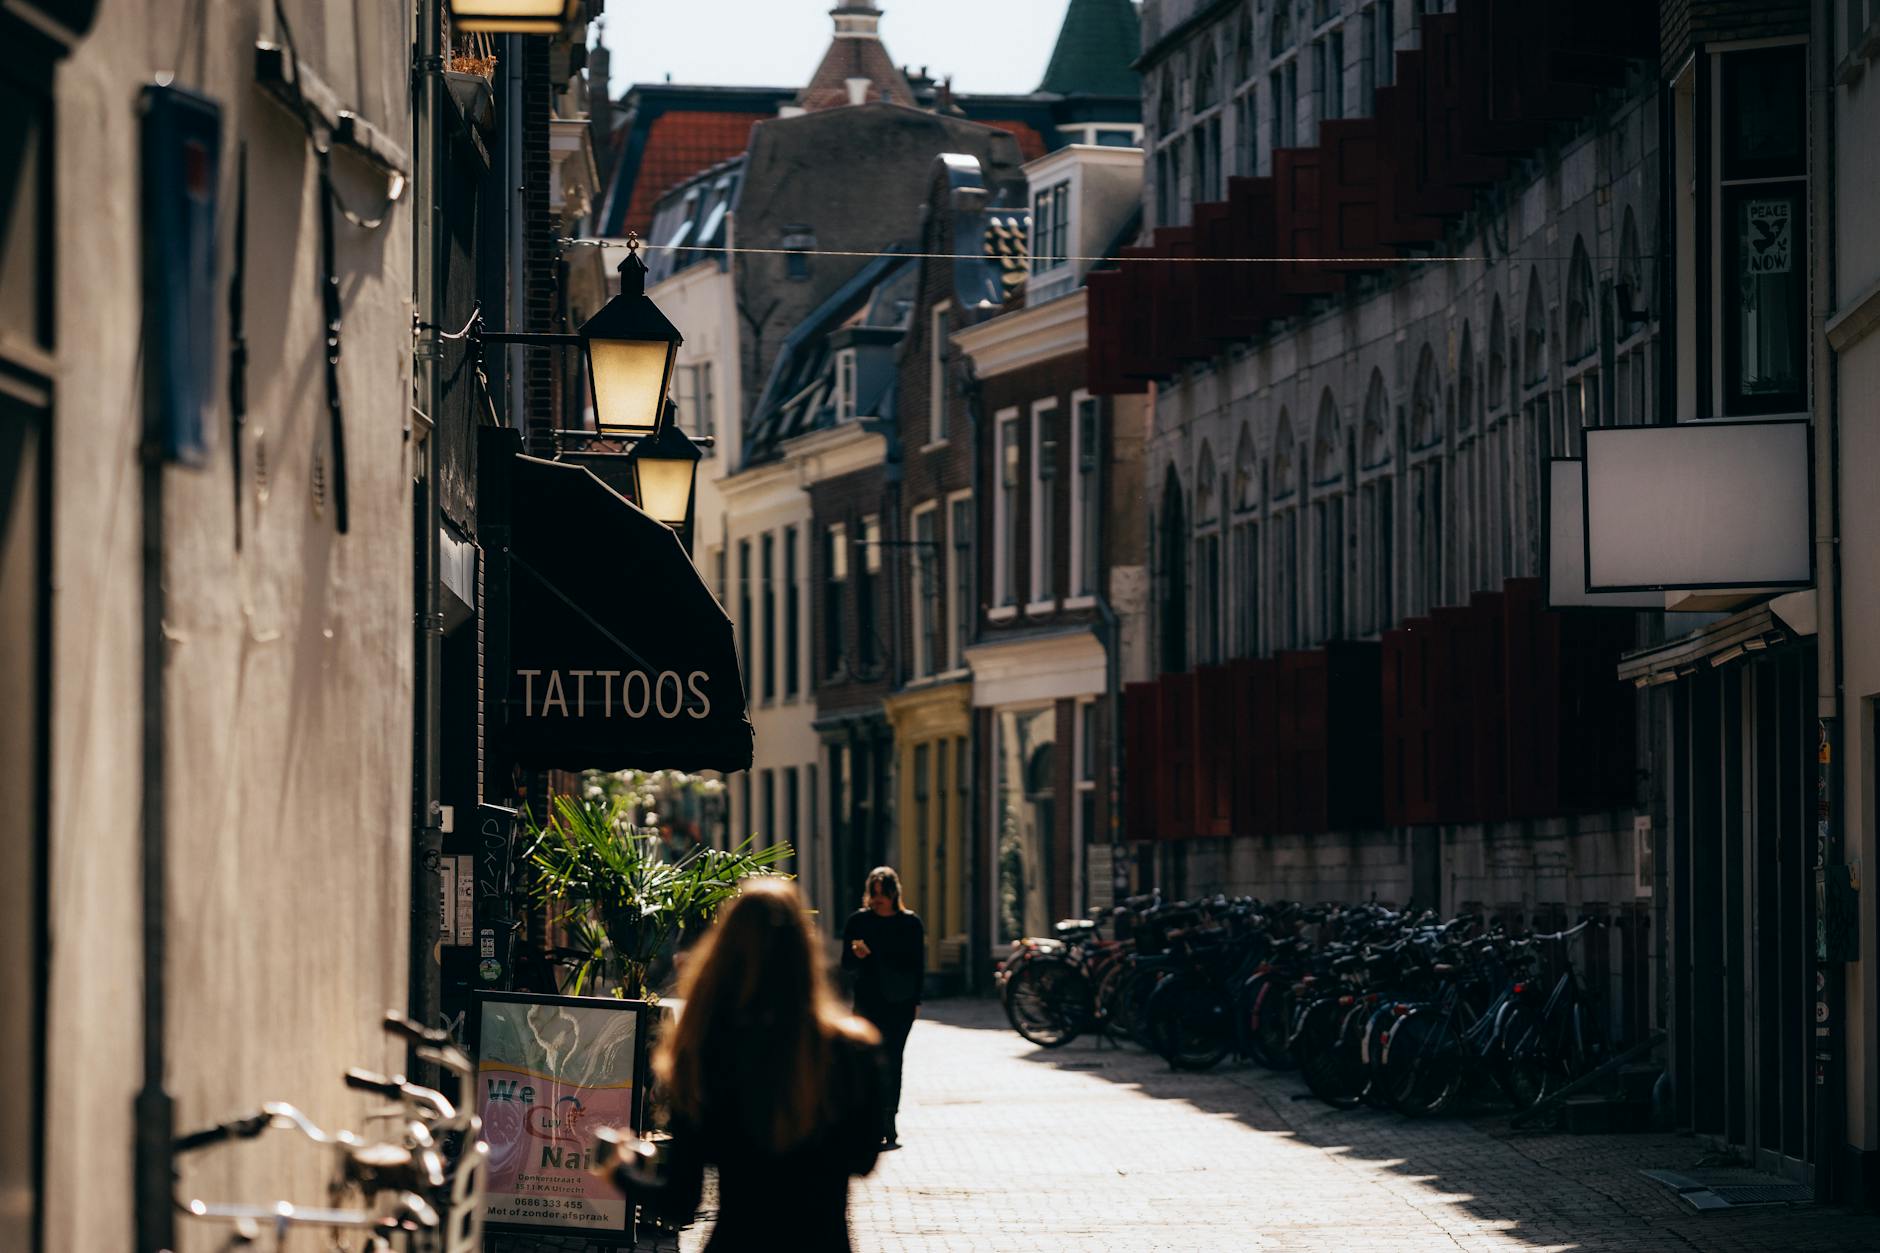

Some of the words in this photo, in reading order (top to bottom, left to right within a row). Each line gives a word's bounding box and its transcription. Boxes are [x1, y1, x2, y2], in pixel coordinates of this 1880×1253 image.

[1750, 205, 1788, 218] PEACE
[1751, 254, 1788, 271] NOW
[516, 669, 711, 719] TATTOOS
[487, 1079, 536, 1103] We
[542, 1116, 561, 1128] Luv
[514, 1198, 540, 1207] 0686
[543, 1199, 561, 1208] 333
[564, 1200, 583, 1209] 455
[487, 1206, 507, 1216] Met
[509, 1207, 521, 1217] of
[522, 1208, 560, 1219] zonder
[562, 1211, 610, 1223] afspraak
